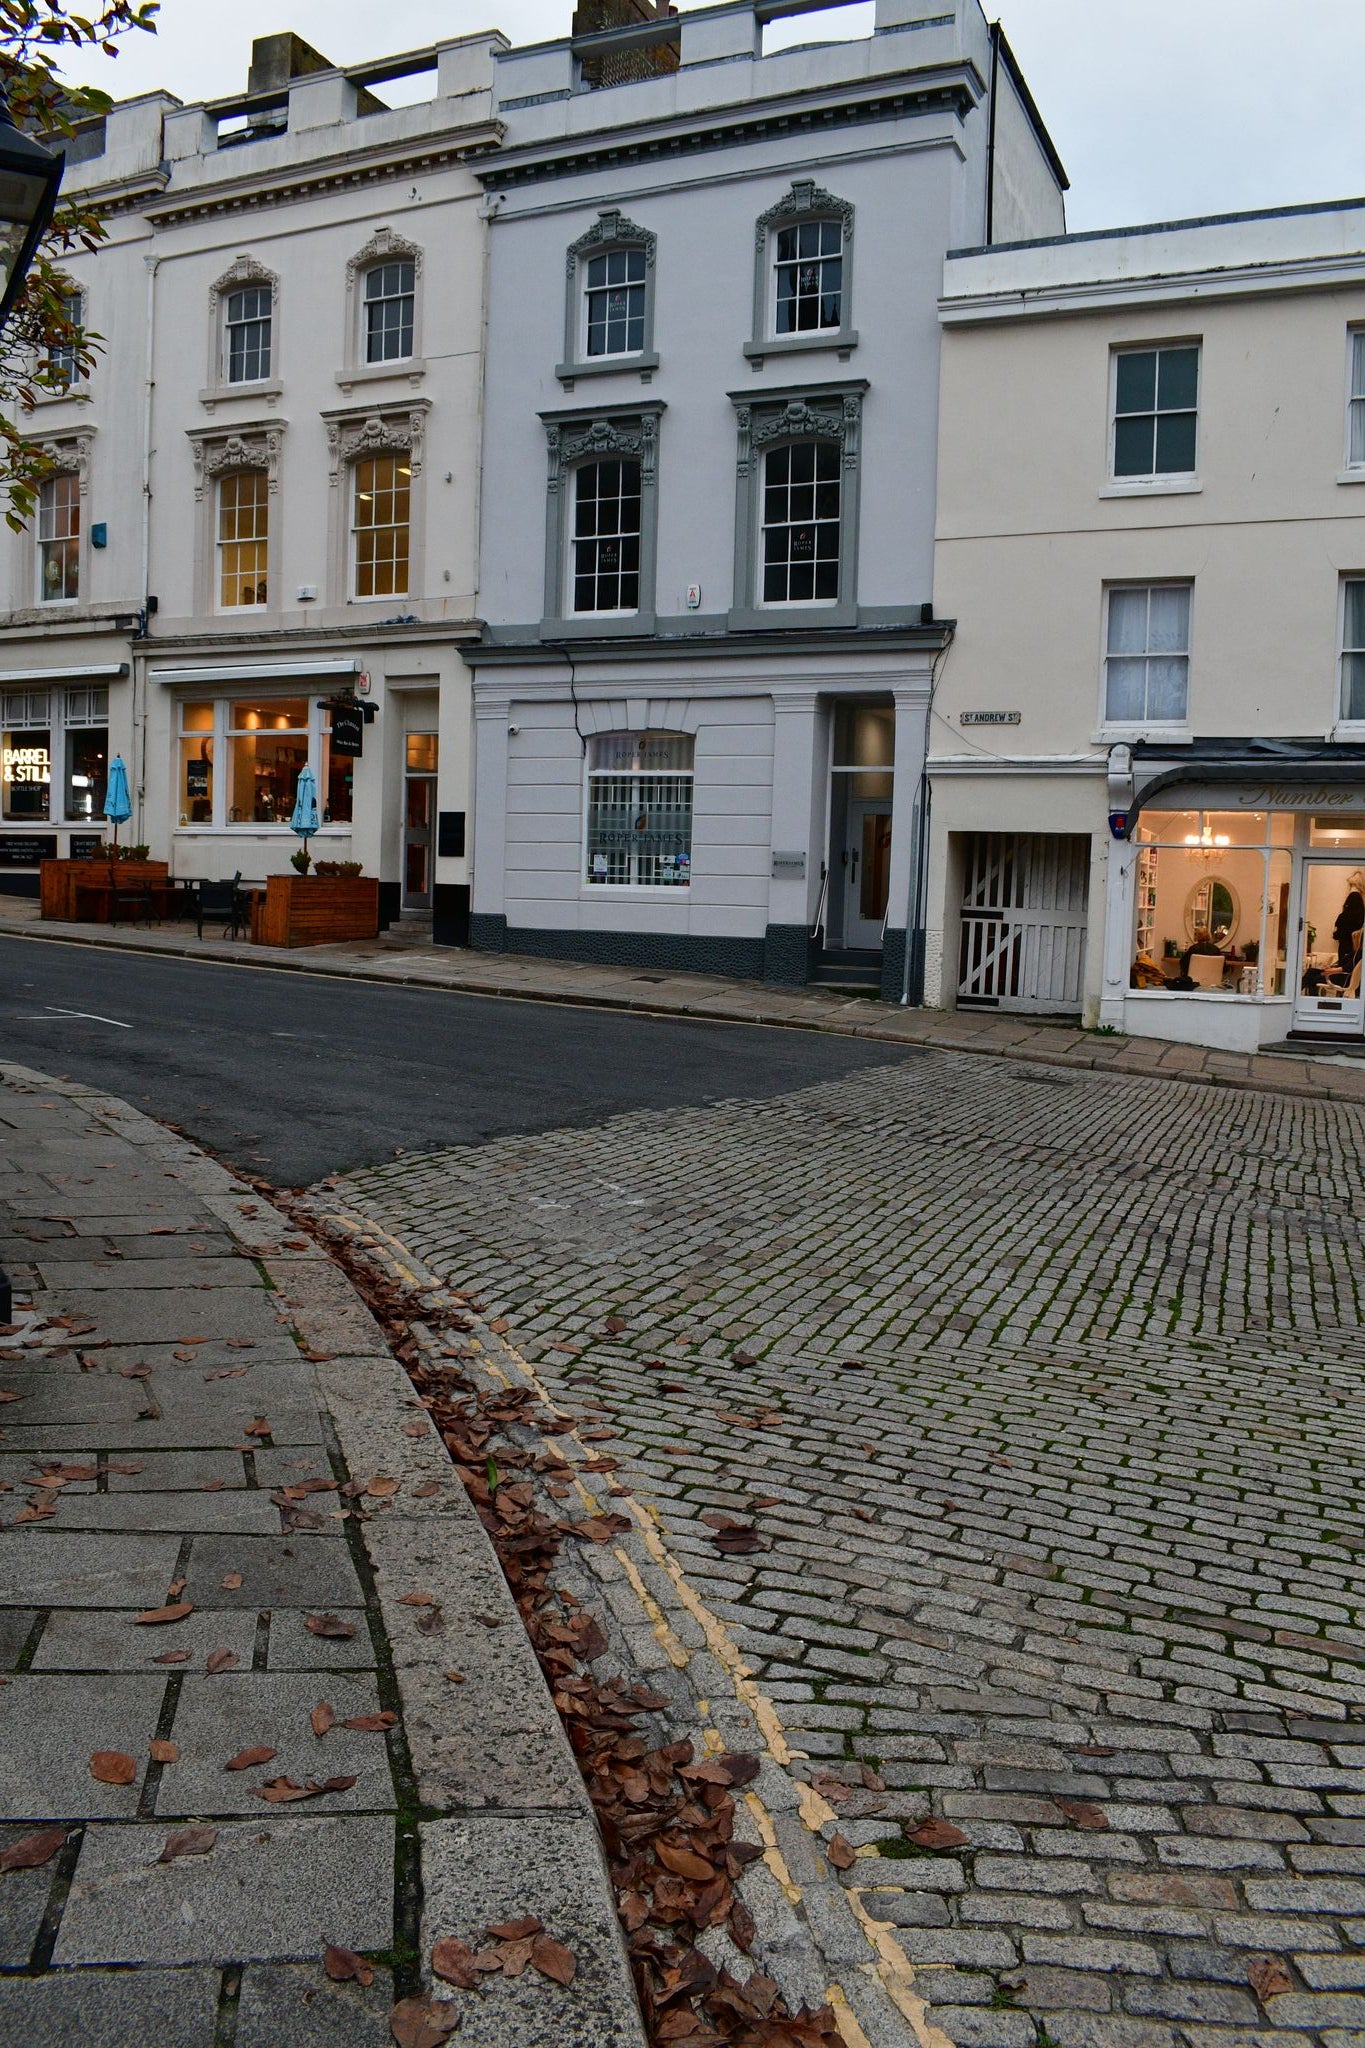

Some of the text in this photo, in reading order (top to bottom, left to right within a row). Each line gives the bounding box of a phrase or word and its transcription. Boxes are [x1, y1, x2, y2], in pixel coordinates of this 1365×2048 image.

[975, 713, 1006, 723] ANDREW
[4, 748, 51, 765] BARREL
[616, 751, 670, 760] ROPER JAMES
[4, 765, 15, 782] &
[1239, 783, 1354, 805] Number
[599, 832, 684, 846] ROPER JAMES
